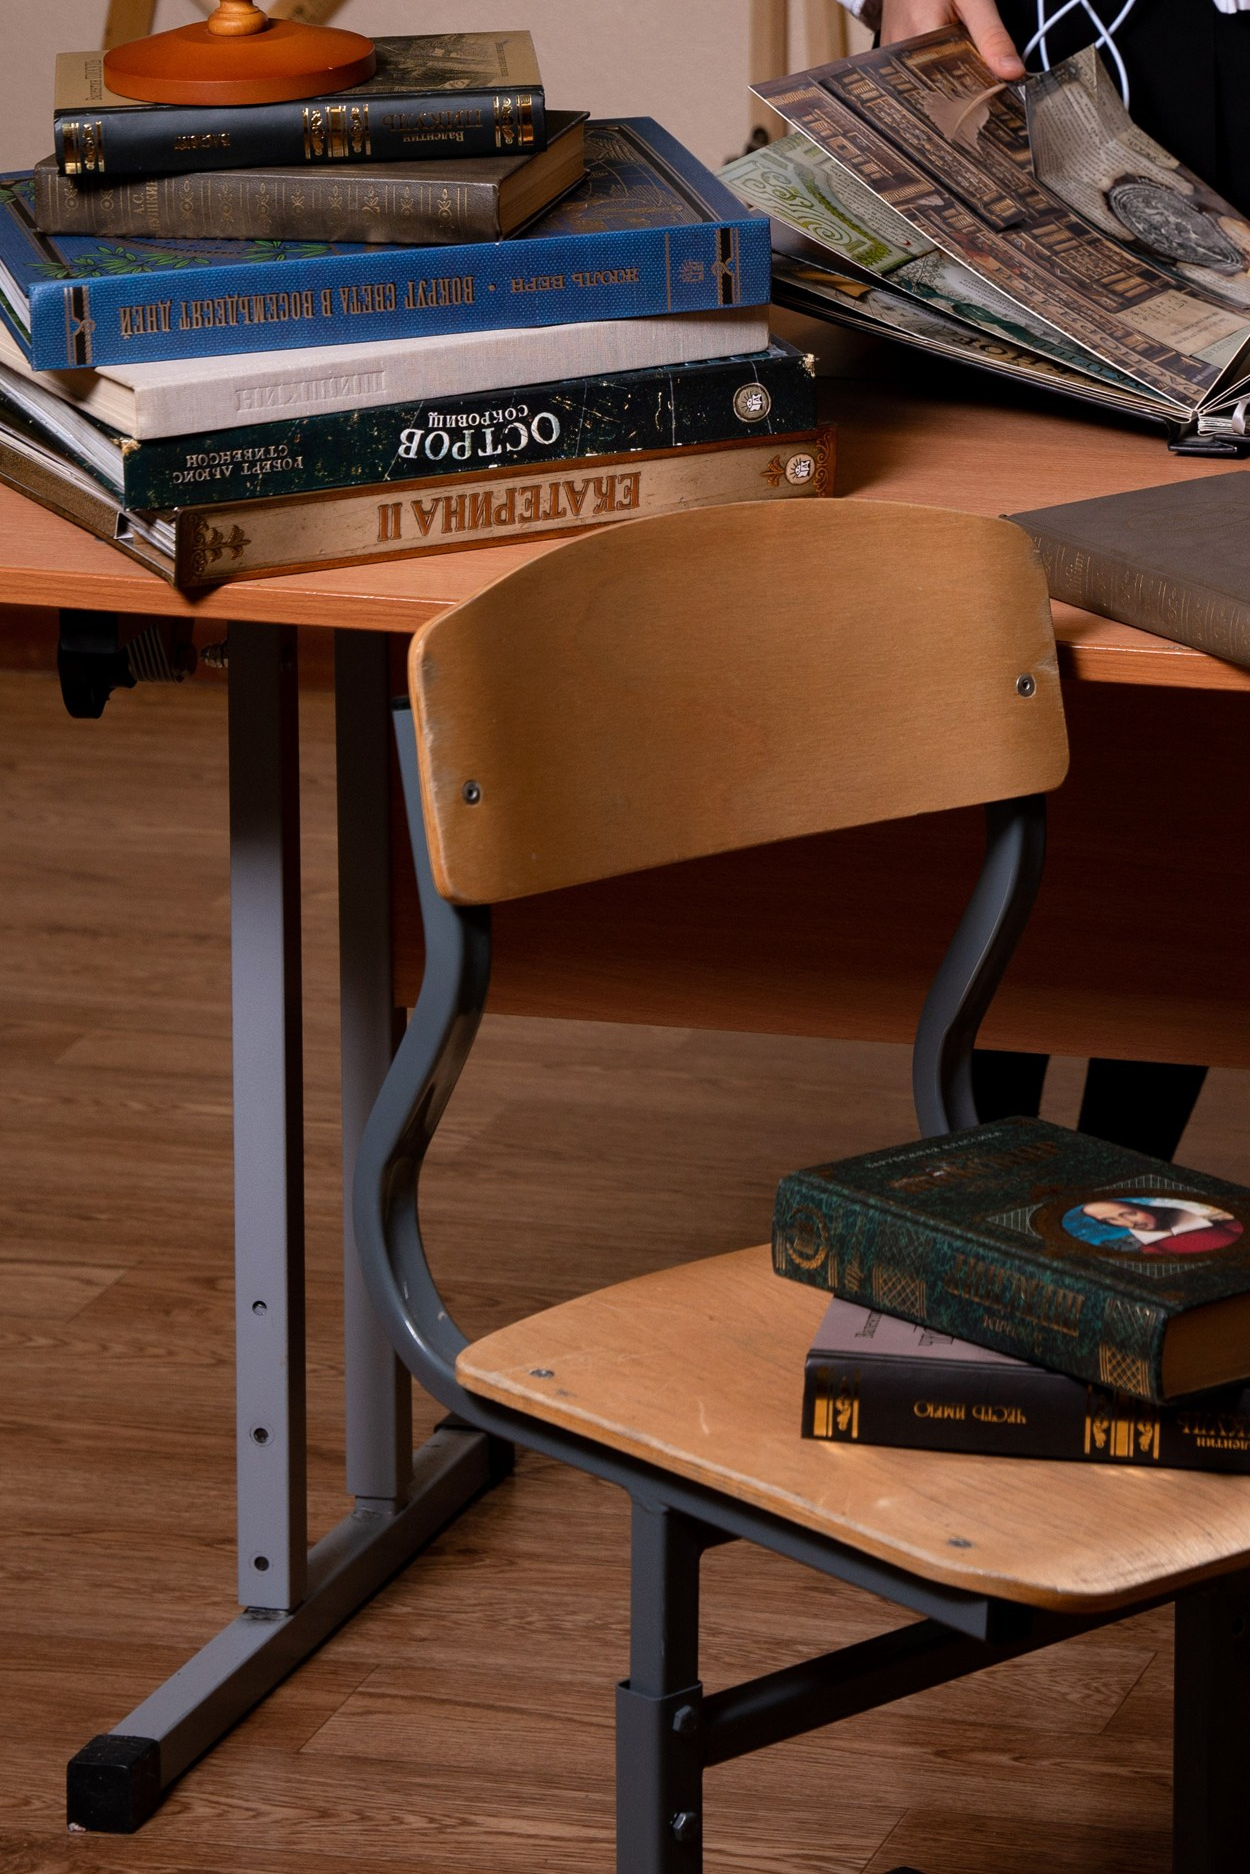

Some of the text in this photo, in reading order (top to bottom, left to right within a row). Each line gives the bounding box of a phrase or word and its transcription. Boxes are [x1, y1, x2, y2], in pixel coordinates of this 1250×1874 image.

[402, 130, 465, 144] Валентин
[118, 267, 640, 340] ЖЮЛЬ ВЕРН ВОКРУГ СВЕТА В ВОСЕМЬДЕСЯТ ДНЕЙ
[427, 403, 529, 429] СОКРОВИЩ
[397, 411, 560, 462] ОСТРОВ
[185, 444, 289, 469] СТИВЕНСОН
[240, 455, 304, 477] РОБЕРТ
[409, 471, 642, 538] ЕКАТЕРИНА
[912, 1400, 1028, 1425] ЧЕСТЬ ИМЕЮ
